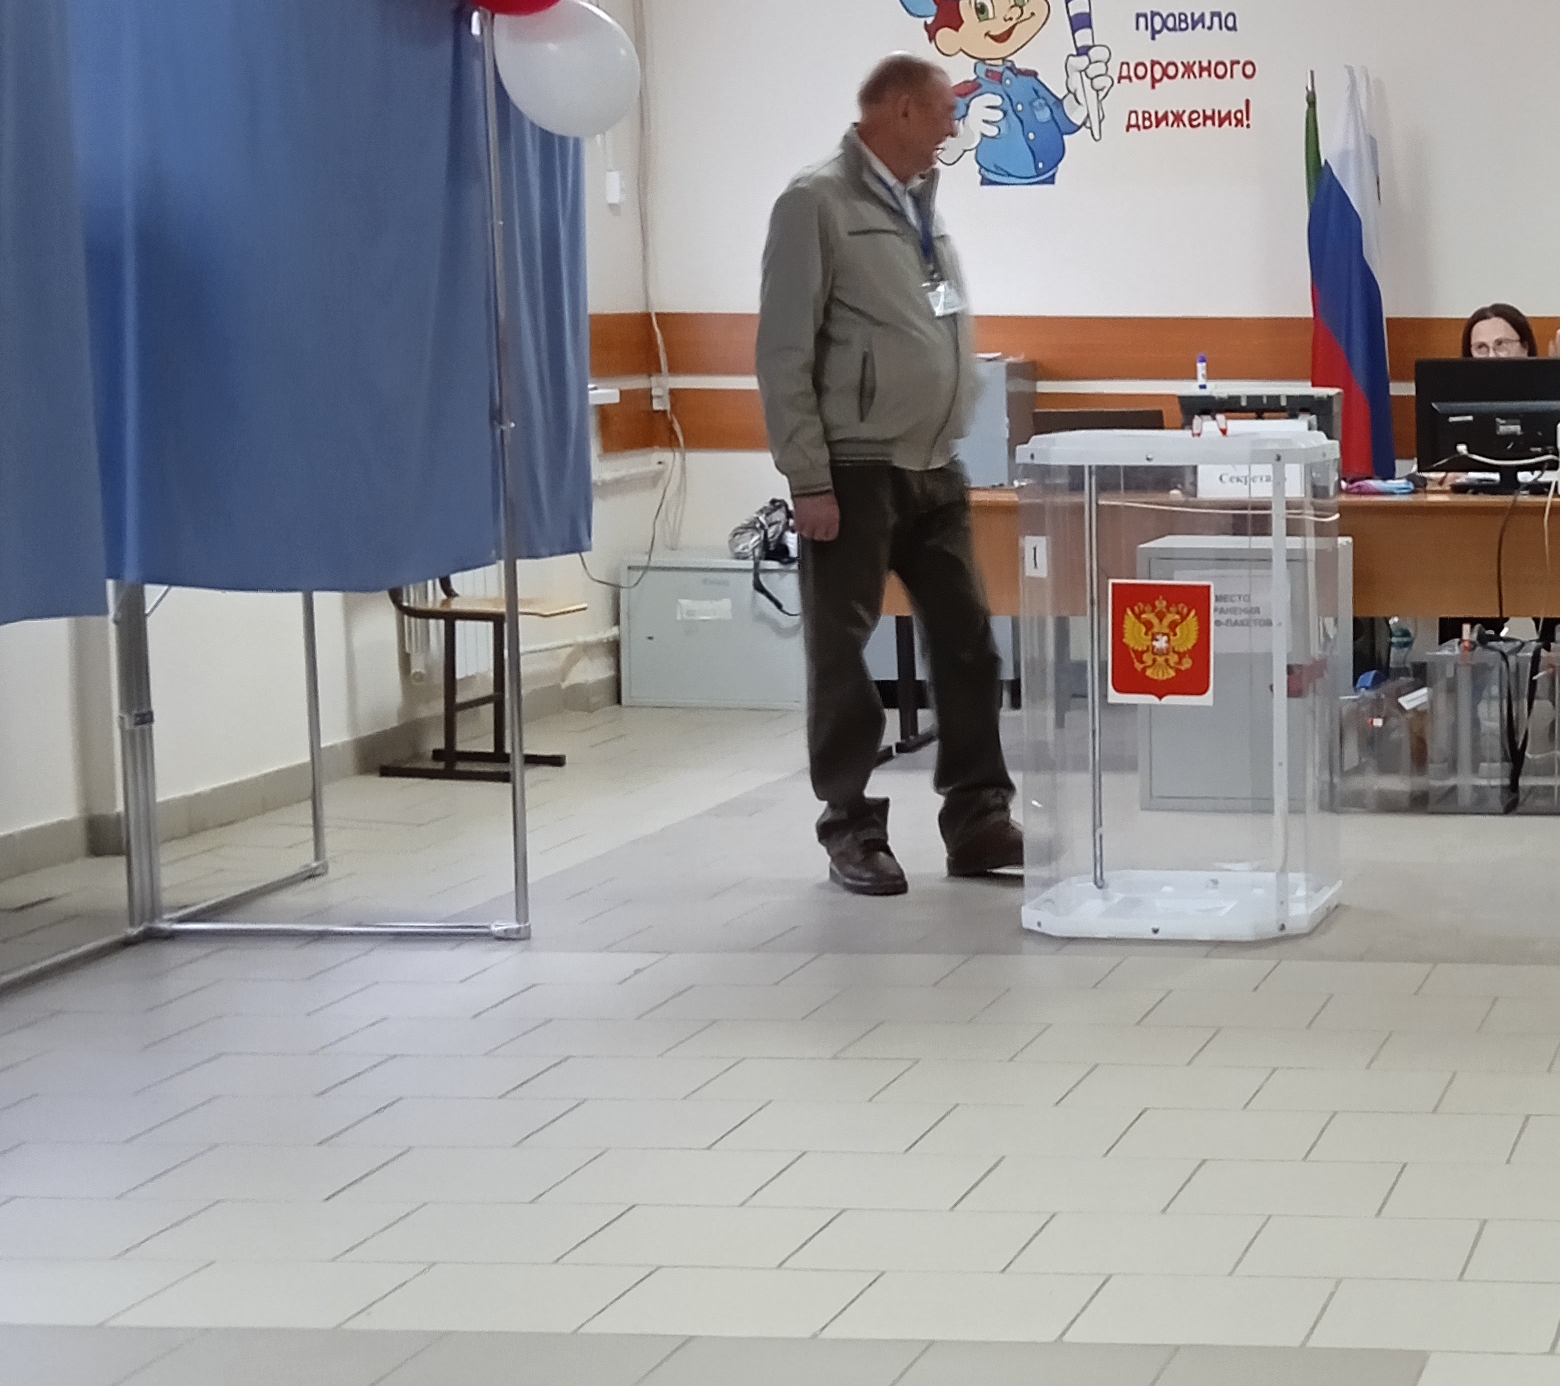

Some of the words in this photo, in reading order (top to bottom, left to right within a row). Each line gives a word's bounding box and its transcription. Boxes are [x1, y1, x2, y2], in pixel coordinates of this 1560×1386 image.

[1134, 10, 1238, 41] правила
[1117, 58, 1257, 90] дорожного
[1125, 98, 1252, 133] движения!
[1218, 472, 1286, 486] Секрета
[1213, 606, 1261, 615] РАНЕНИЯ
